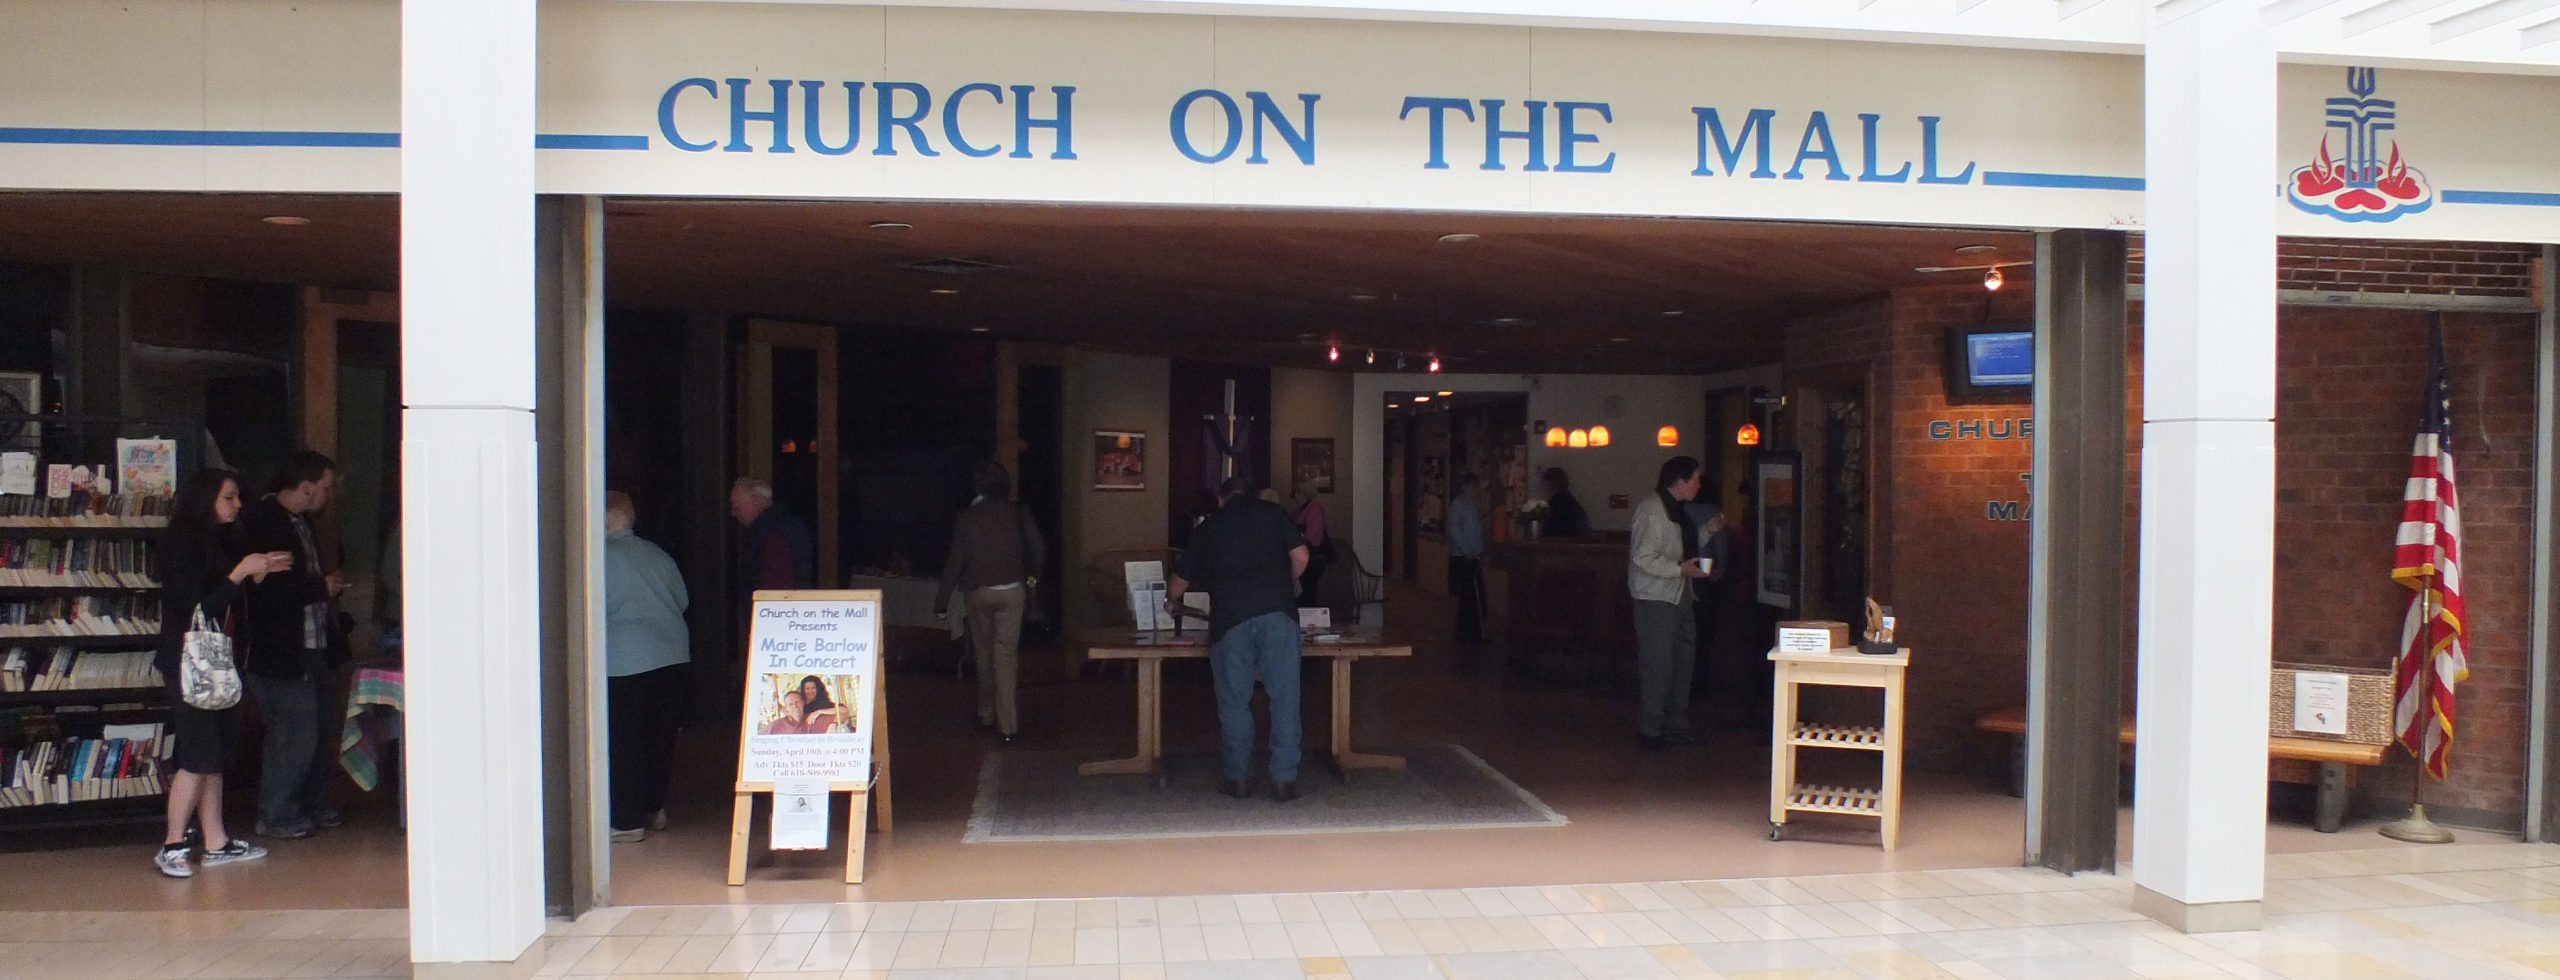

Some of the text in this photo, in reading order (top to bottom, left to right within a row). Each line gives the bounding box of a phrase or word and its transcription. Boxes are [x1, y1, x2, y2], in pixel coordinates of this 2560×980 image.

[657, 77, 1976, 184] CHURCH ON THE MALL
[760, 608, 868, 618] Church on the Mall
[788, 621, 838, 631] Presents
[760, 638, 868, 652] Marie Barlow
[769, 654, 857, 668] In Concert
[785, 748, 804, 758] April
[850, 747, 865, 755] PM
[754, 760, 769, 768] Adv
[772, 760, 789, 769] Tkts
[807, 760, 827, 769] Door
[829, 760, 846, 768] Tkts
[773, 769, 789, 777] Call
